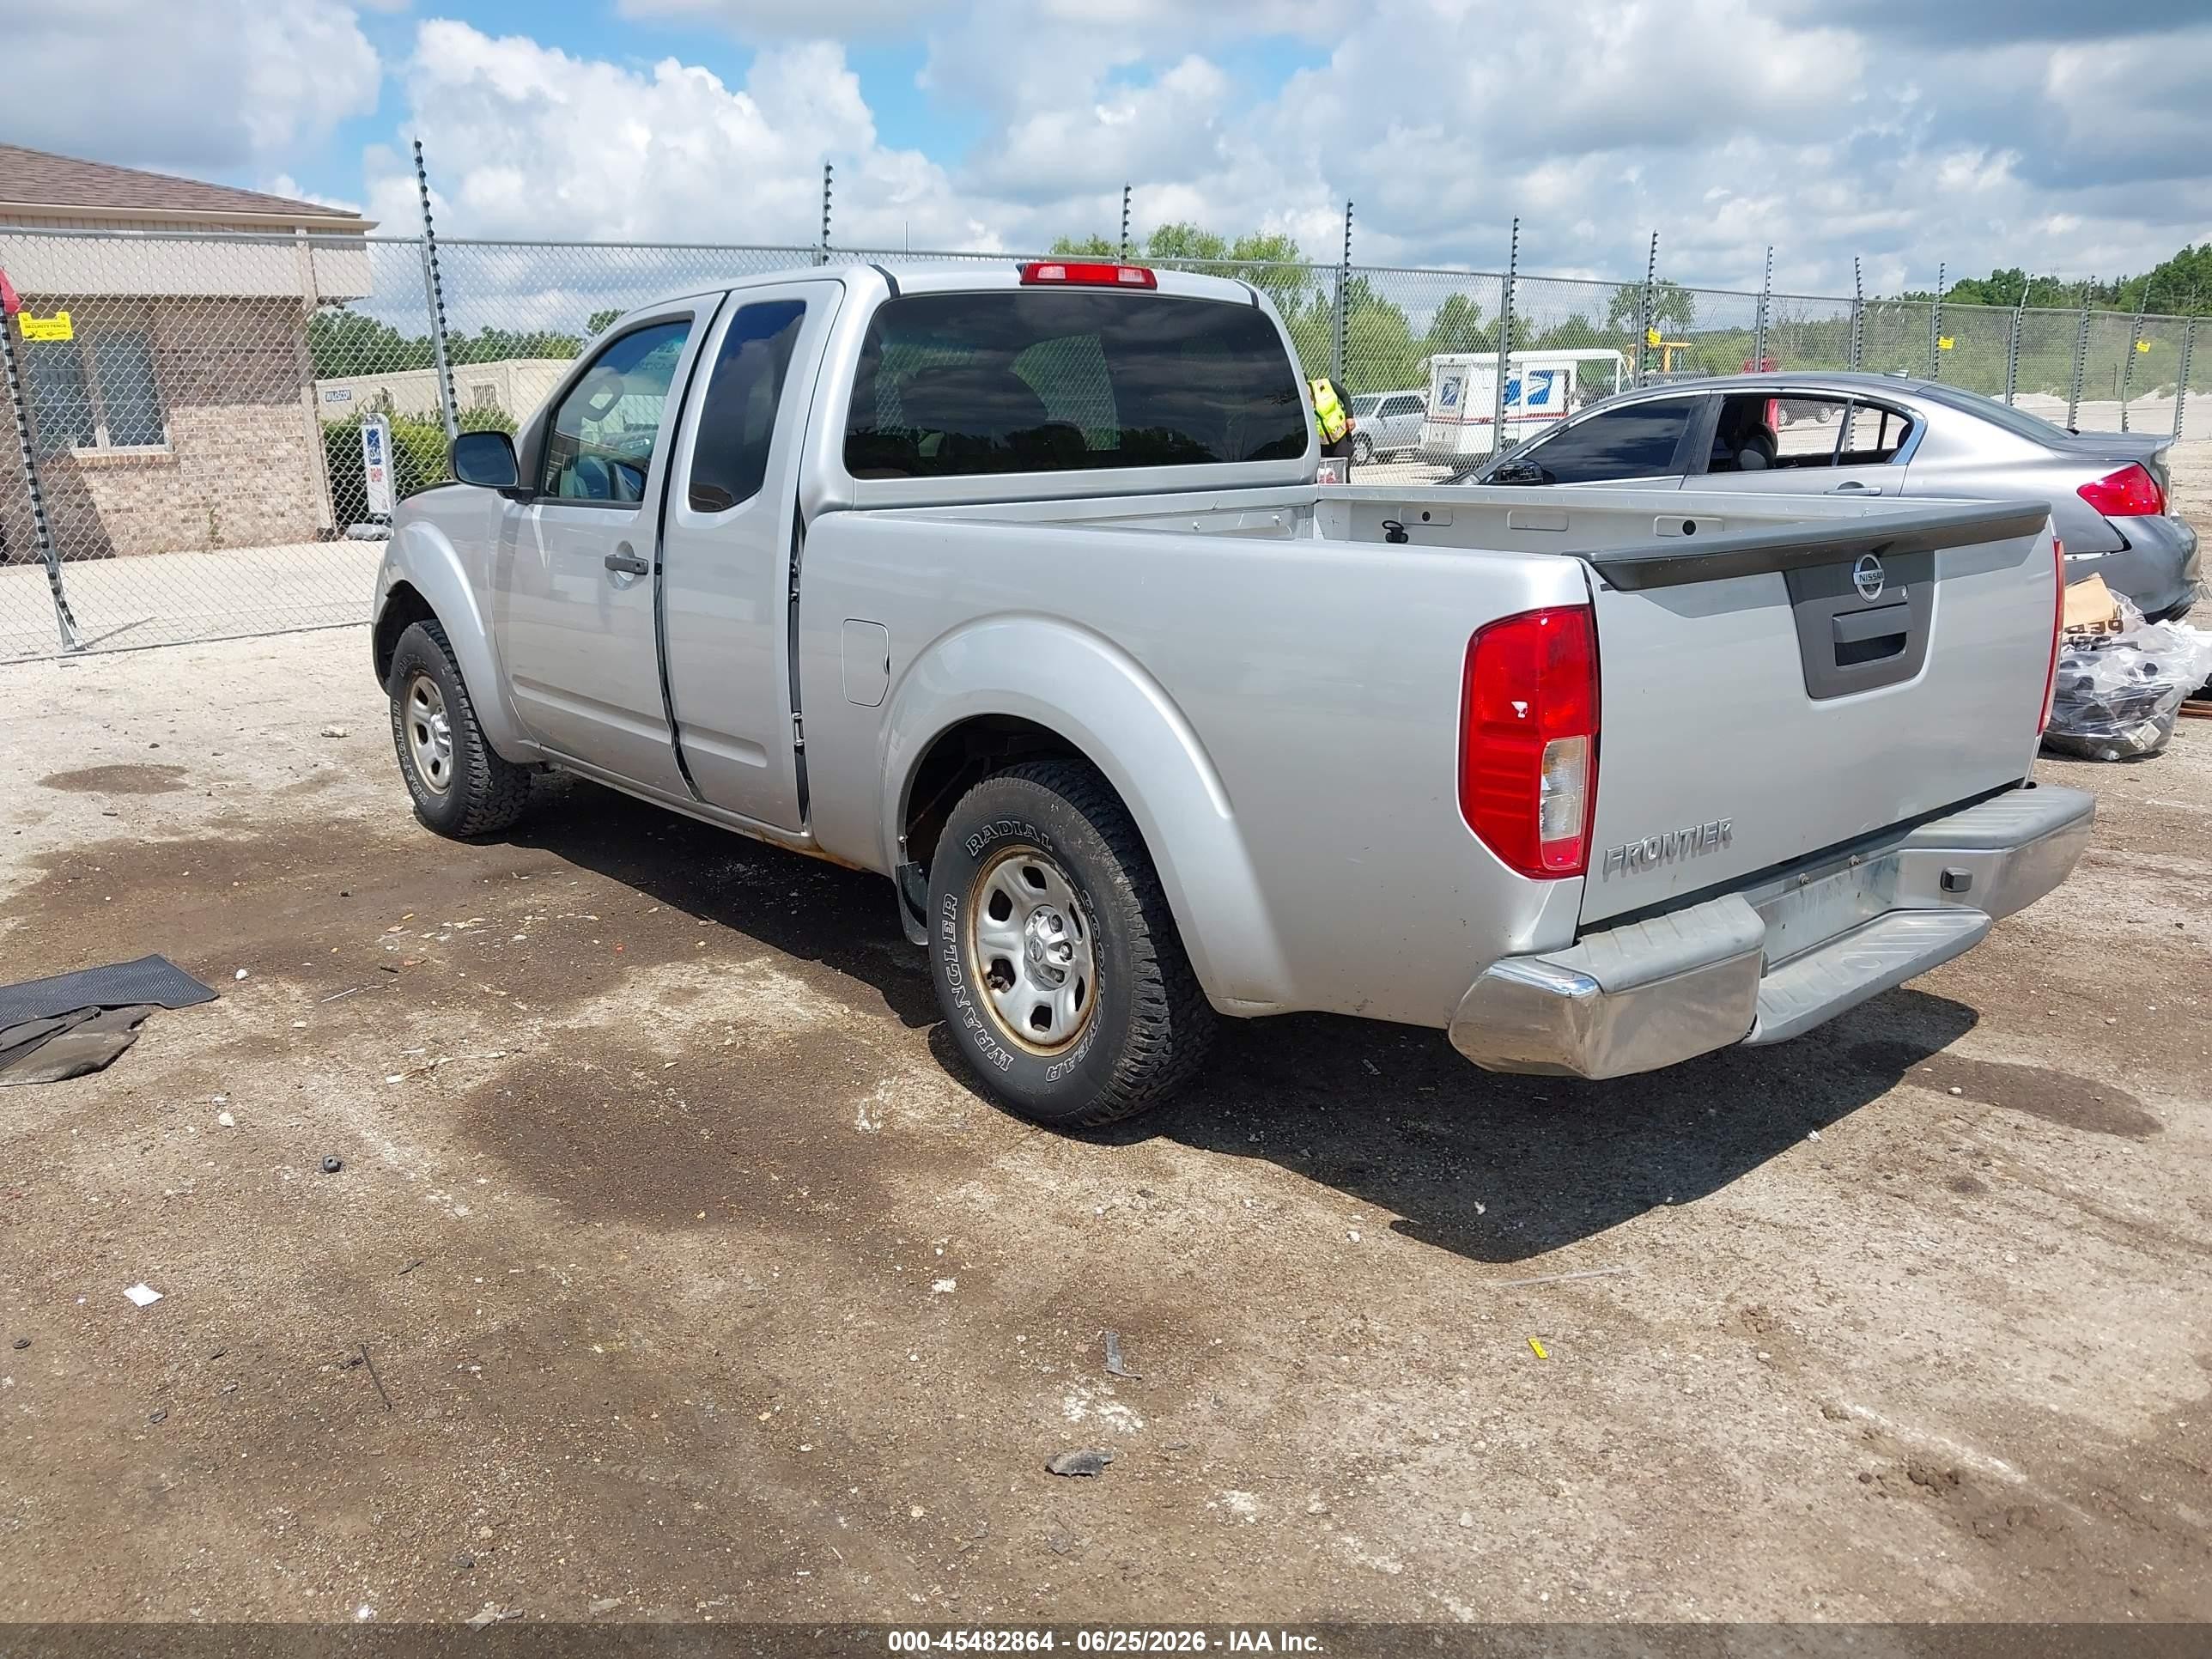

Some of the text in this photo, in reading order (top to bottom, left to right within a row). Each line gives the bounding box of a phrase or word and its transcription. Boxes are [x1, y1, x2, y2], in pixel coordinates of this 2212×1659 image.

[965, 820, 1053, 857] RADIAL
[1602, 817, 1733, 877] FRONTIER
[941, 892, 1015, 1072] WRANGLER
[1044, 889, 1105, 1083] GOODYEAR
